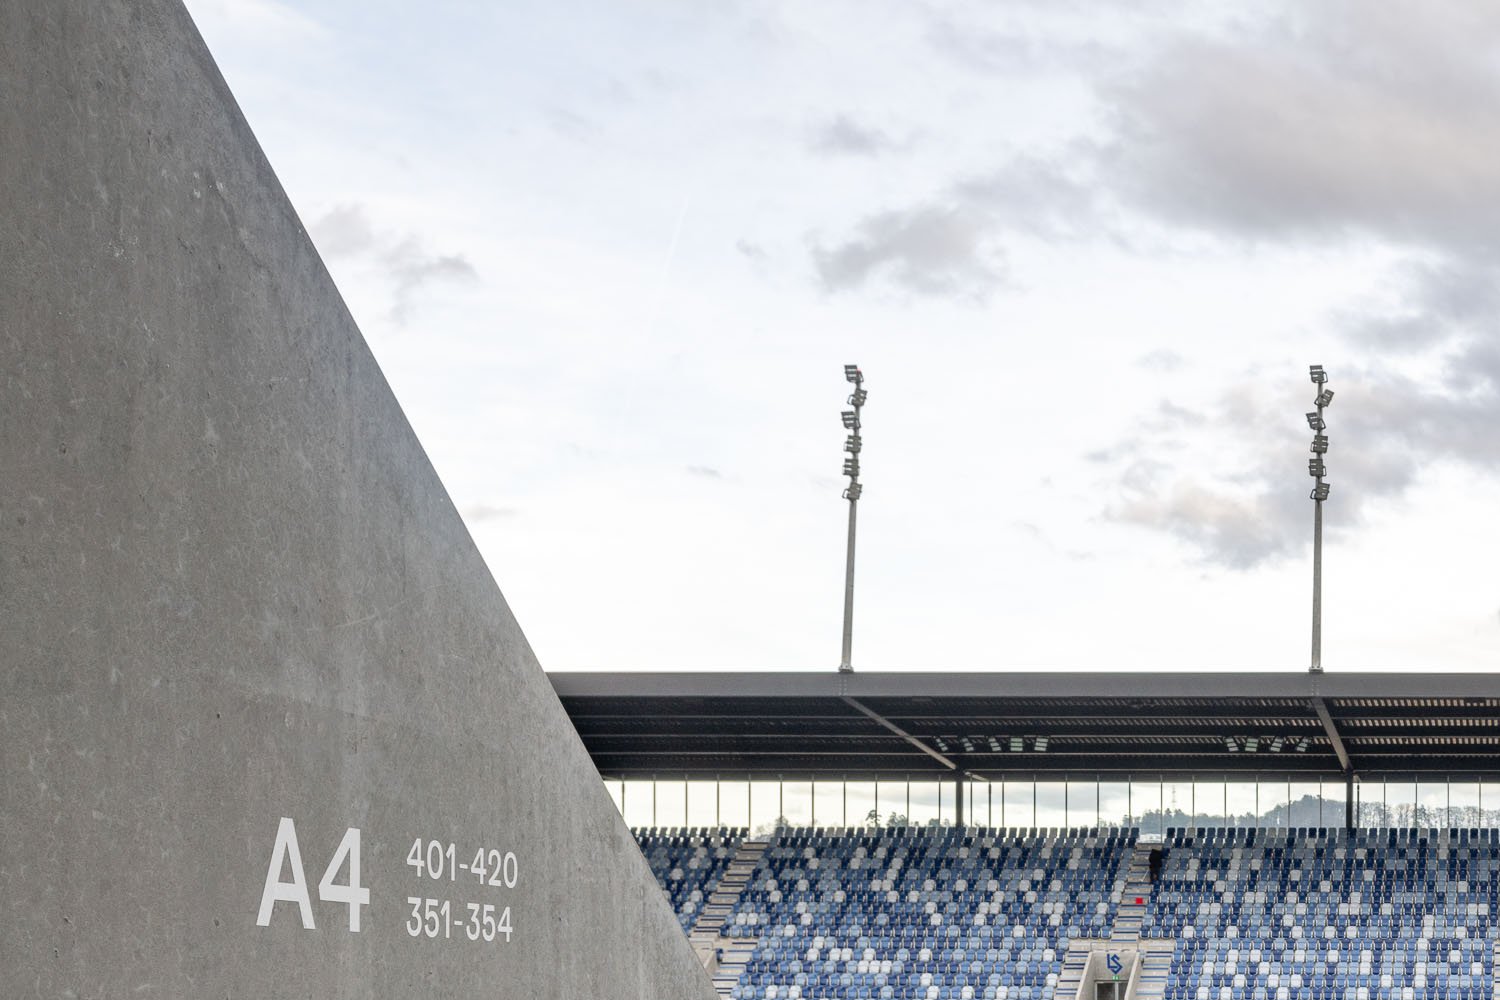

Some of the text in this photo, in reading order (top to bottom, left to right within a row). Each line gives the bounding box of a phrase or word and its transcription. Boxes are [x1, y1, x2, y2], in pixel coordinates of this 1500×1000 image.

[256, 817, 370, 932] A4
[406, 838, 518, 888] 401-420
[406, 896, 513, 942] 351-354
